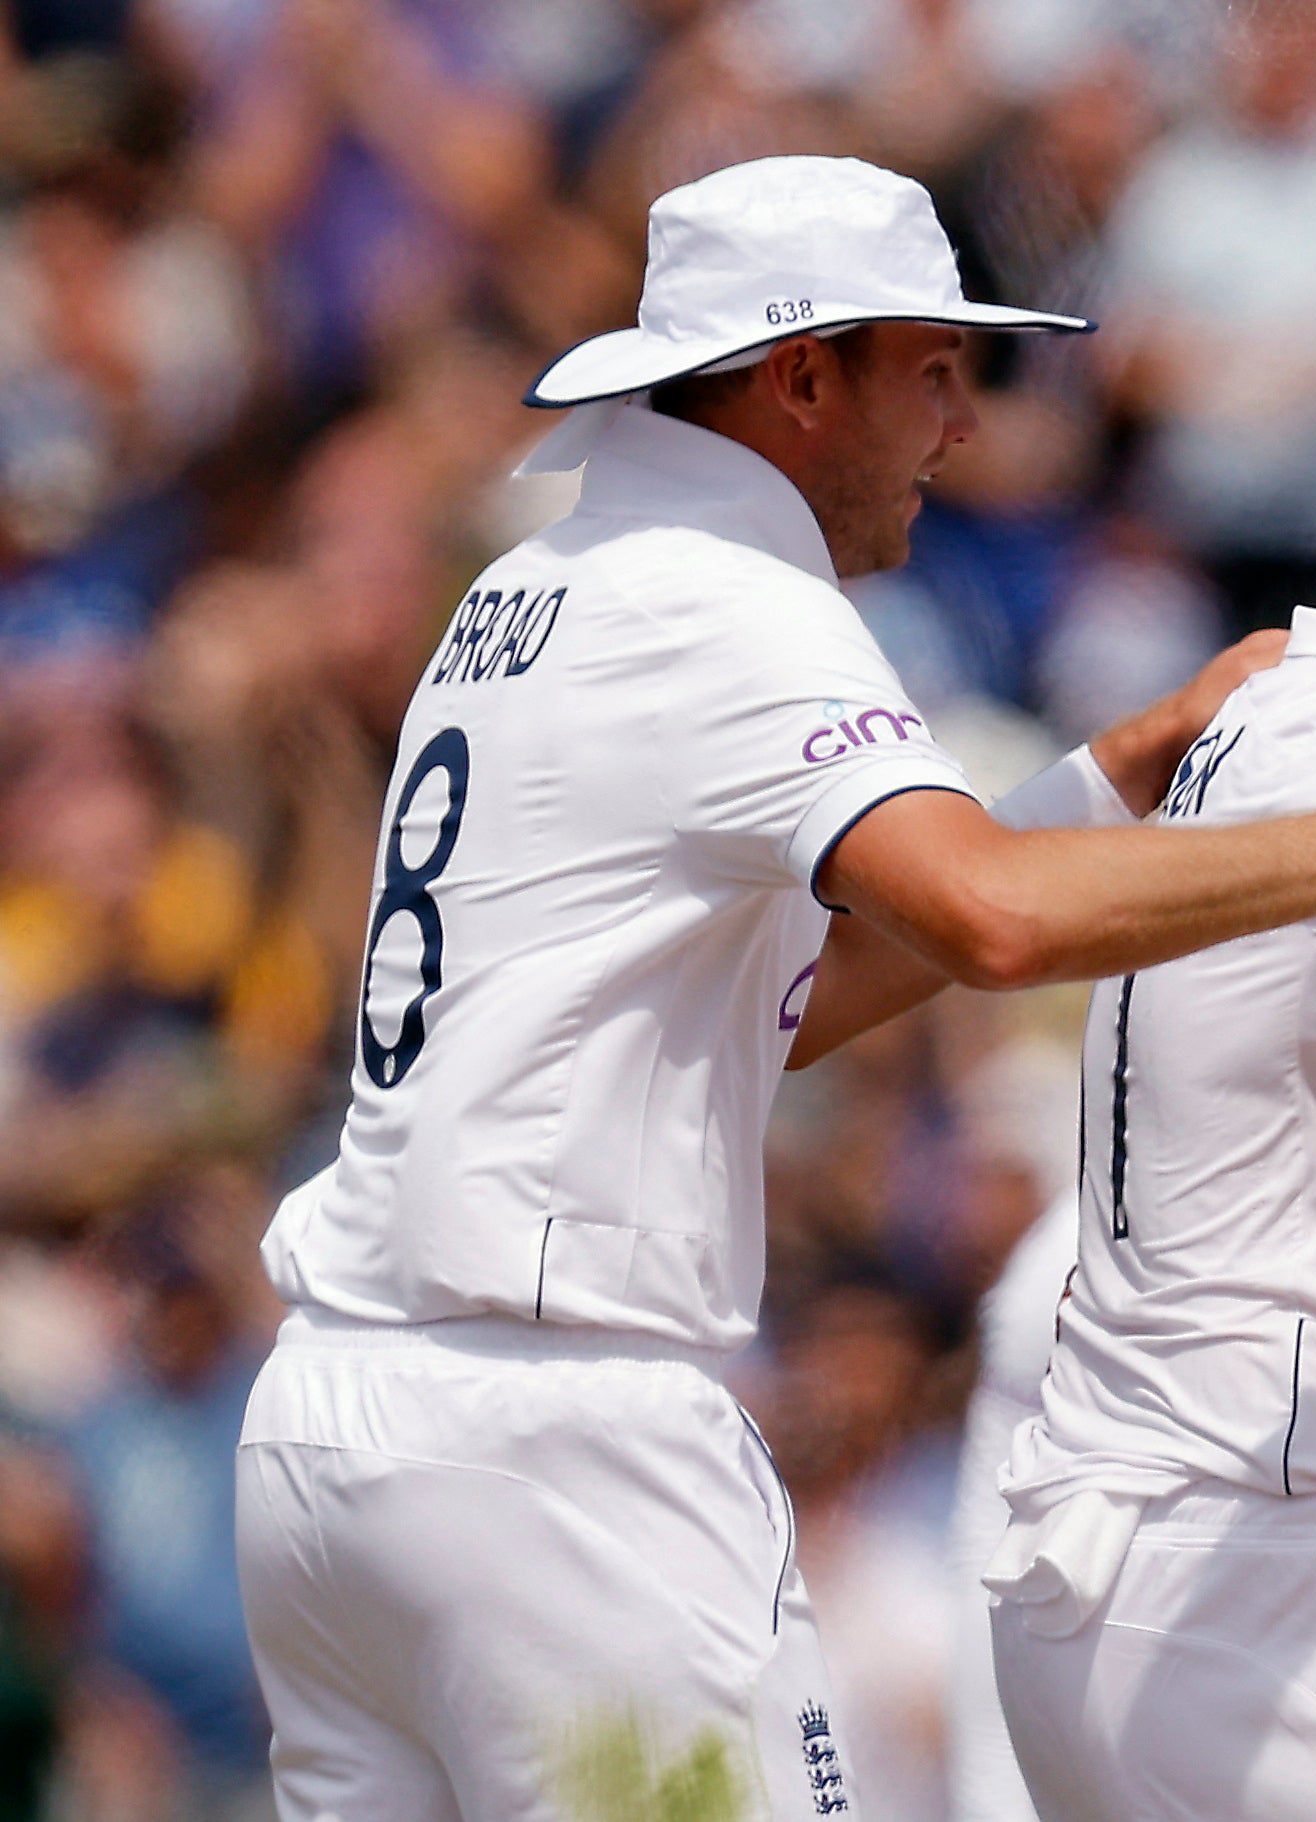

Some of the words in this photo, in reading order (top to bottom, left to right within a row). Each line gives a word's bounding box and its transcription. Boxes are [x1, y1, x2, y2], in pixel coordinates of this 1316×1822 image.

[766, 299, 814, 325] 638
[432, 587, 568, 684] BROAD
[362, 727, 471, 1089] 8
